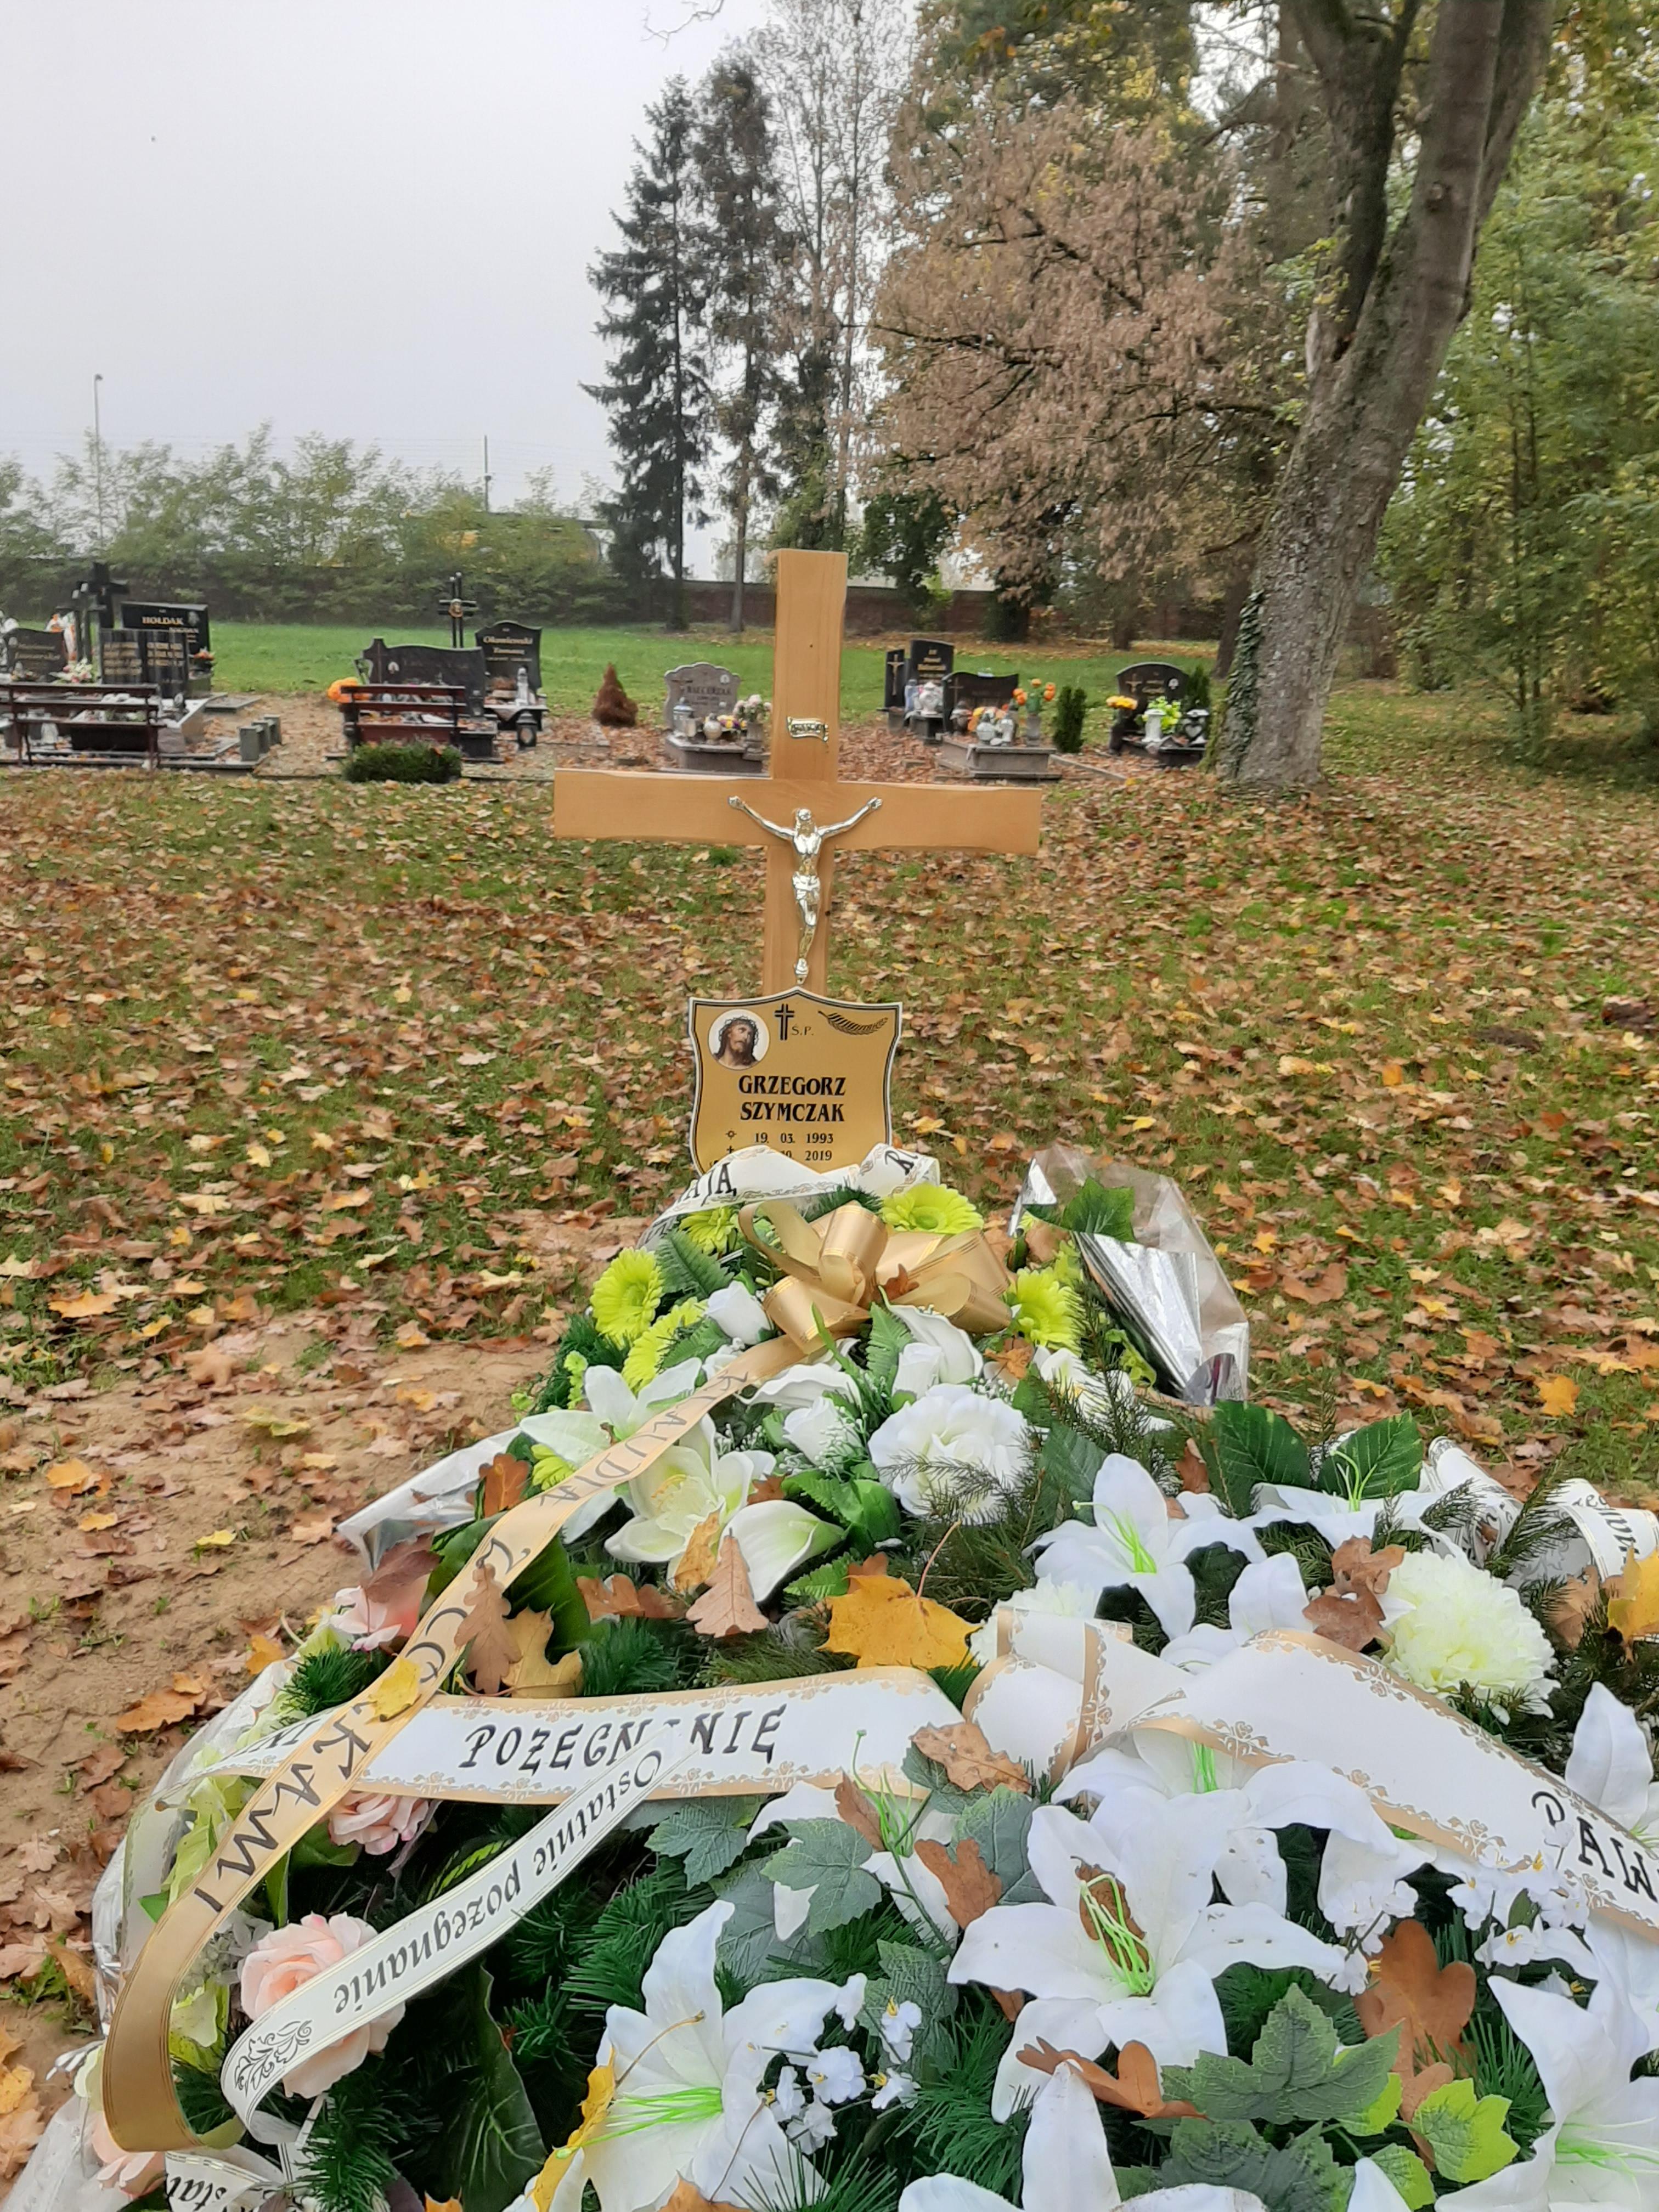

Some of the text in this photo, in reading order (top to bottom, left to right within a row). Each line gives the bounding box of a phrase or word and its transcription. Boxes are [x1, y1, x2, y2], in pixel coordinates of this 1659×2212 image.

[738, 1075, 846, 1096] GRZEGORZ
[740, 1102, 845, 1122] SZYMCZAK
[806, 1132, 833, 1144] 1993
[805, 1149, 832, 1161] 2019
[532, 1750, 662, 1878] Ostatnie
